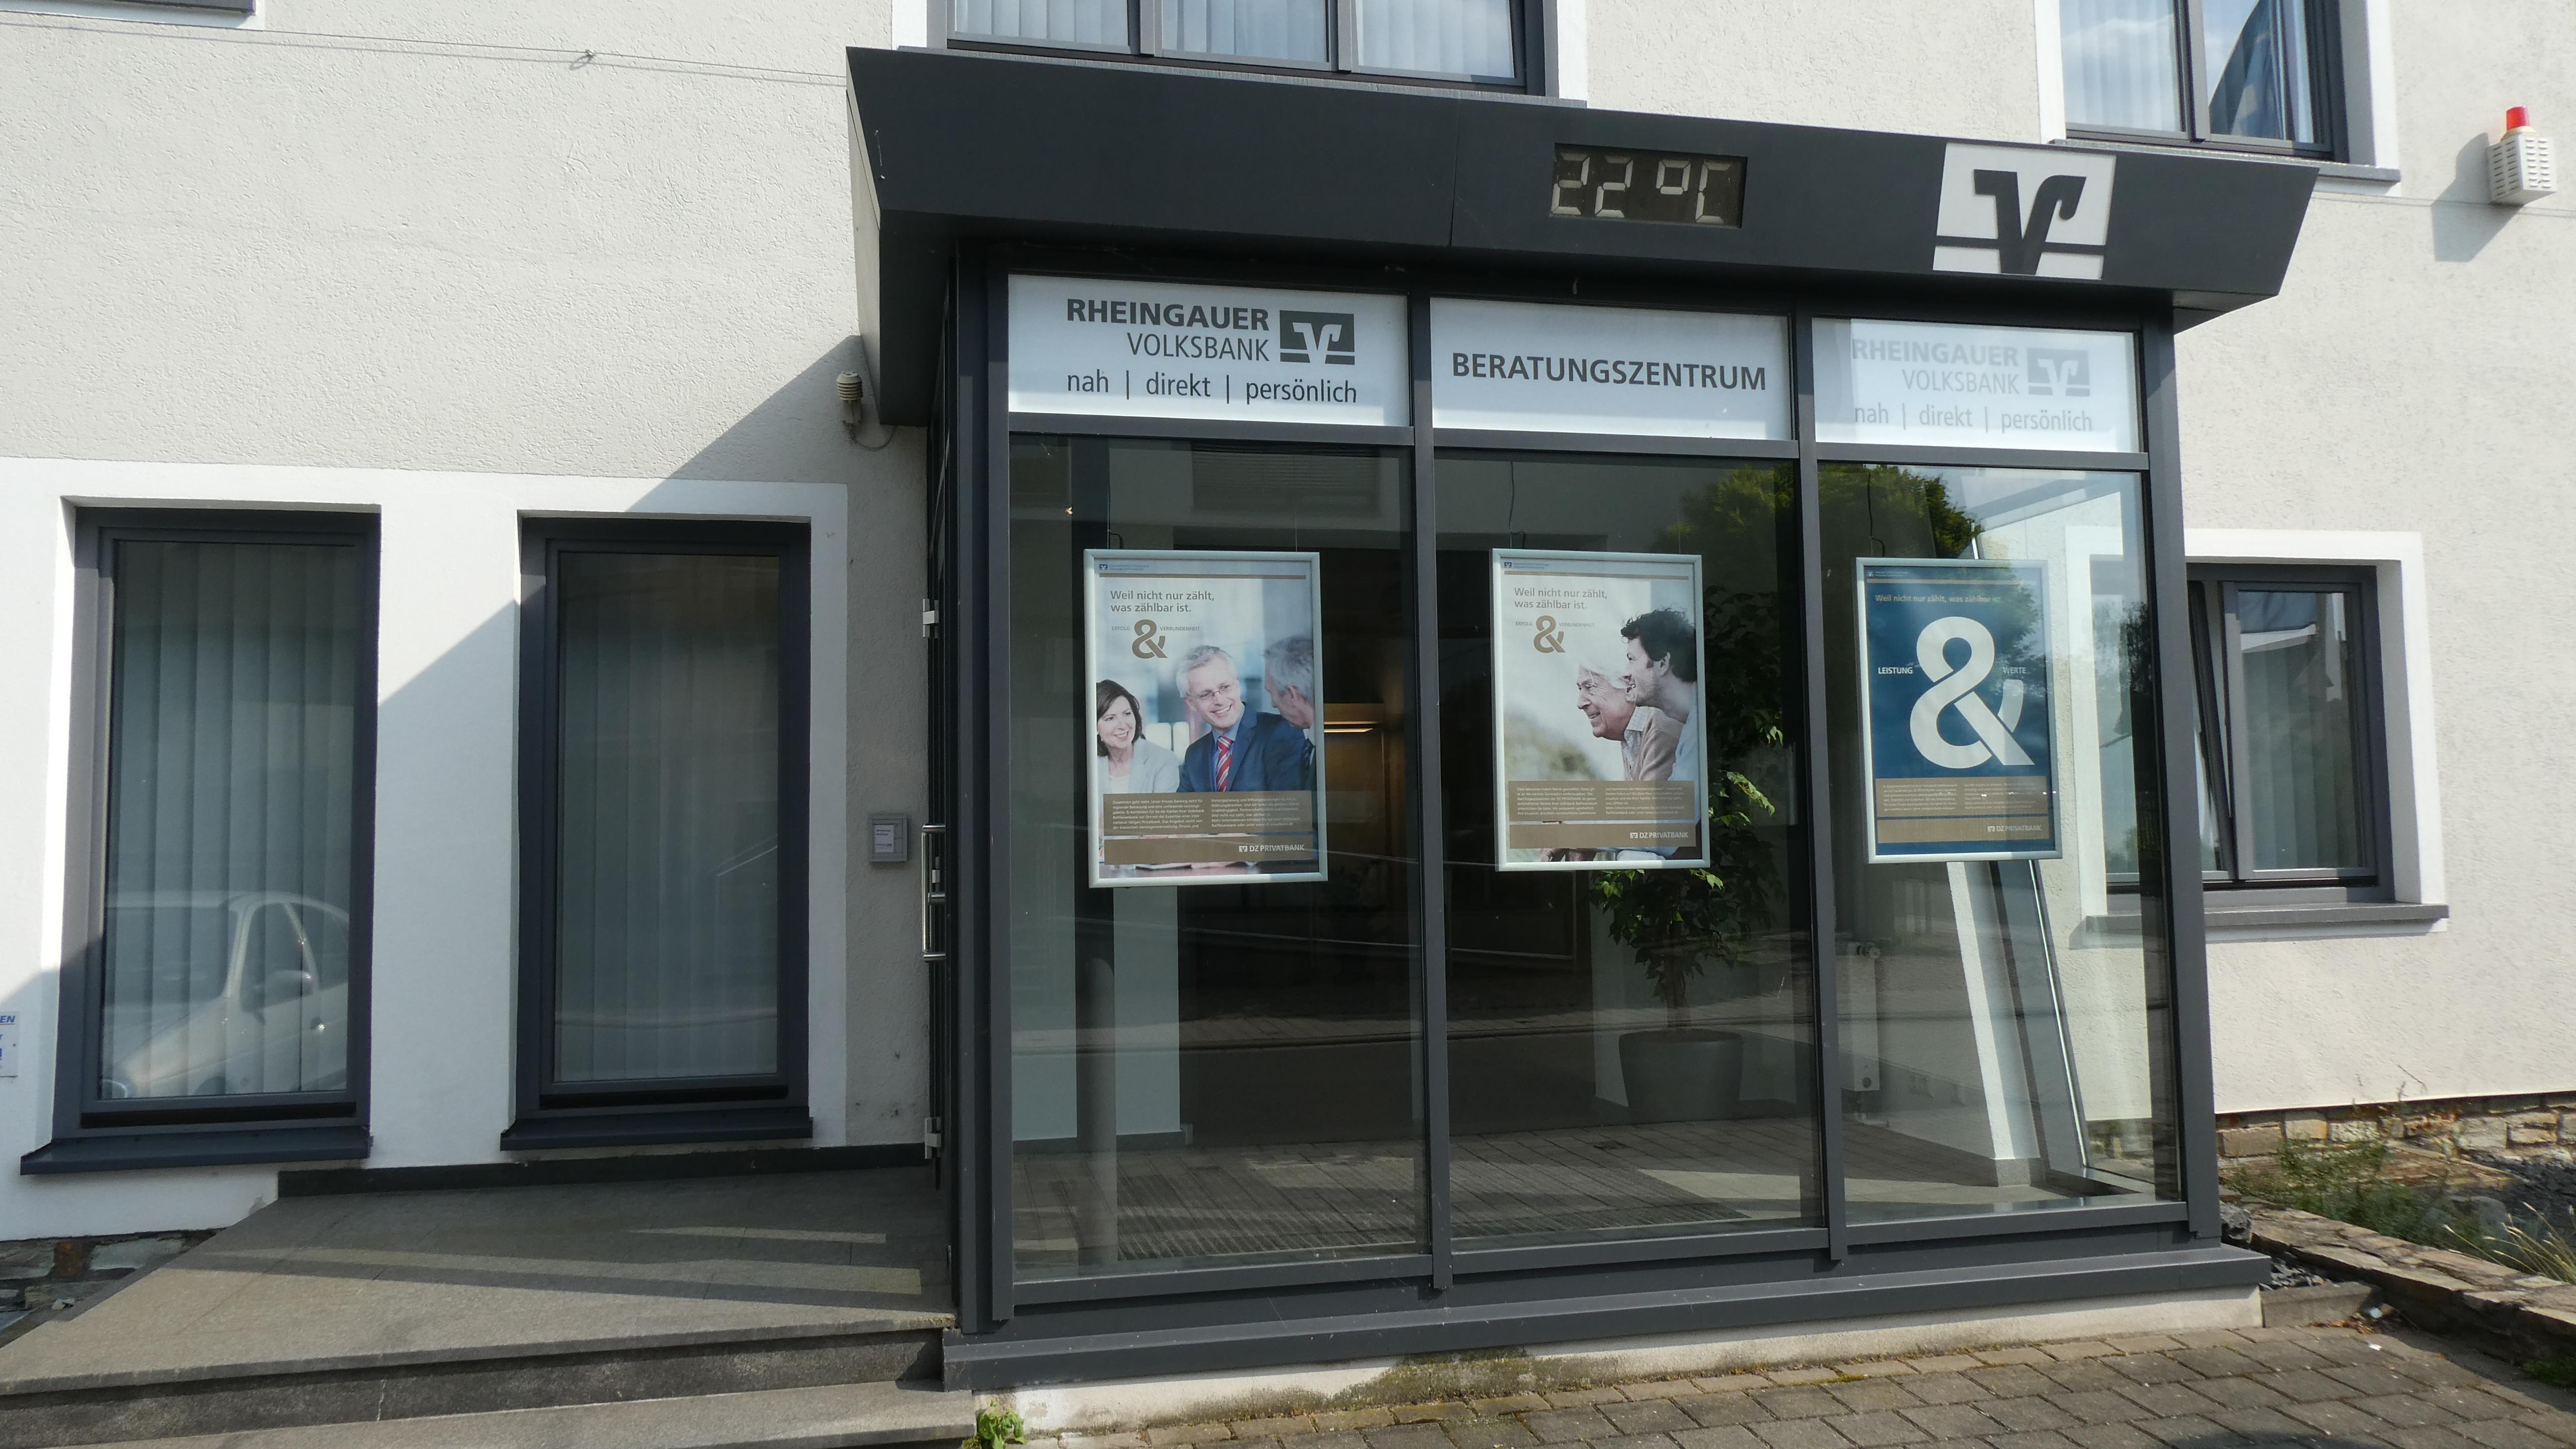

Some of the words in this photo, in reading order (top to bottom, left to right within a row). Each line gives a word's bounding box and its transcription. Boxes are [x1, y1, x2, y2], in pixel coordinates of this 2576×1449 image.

[1551, 152, 1633, 219] 22
[1067, 299, 1270, 331] RHEINGAUER
[1127, 332, 1270, 362] VOLKSBANK
[1852, 338, 2019, 367] RHEINGAUER
[1068, 369, 1109, 393] nah
[1146, 372, 1211, 398] direkt
[1246, 380, 1357, 404] persönlich
[1452, 352, 1766, 390] BERATUNGSZENTRUM
[1902, 369, 2019, 394] VOLKSBANK
[1855, 402, 1888, 423] nah
[1919, 404, 1972, 427] direkt
[2001, 409, 2092, 433] persönlich
[1111, 591, 1133, 600] Weil
[1137, 591, 1162, 600] nicht
[1187, 591, 1214, 601] zählt,
[1135, 603, 1173, 613] zählbar
[1177, 603, 1191, 612] ist.
[1514, 588, 1534, 596] Weil
[1538, 588, 1561, 597] nicht
[1582, 589, 1608, 599] zählt,
[1536, 600, 1570, 609] zählbar
[1132, 619, 1168, 659] &
[1533, 616, 1566, 653] &
[1910, 616, 2035, 768] &
